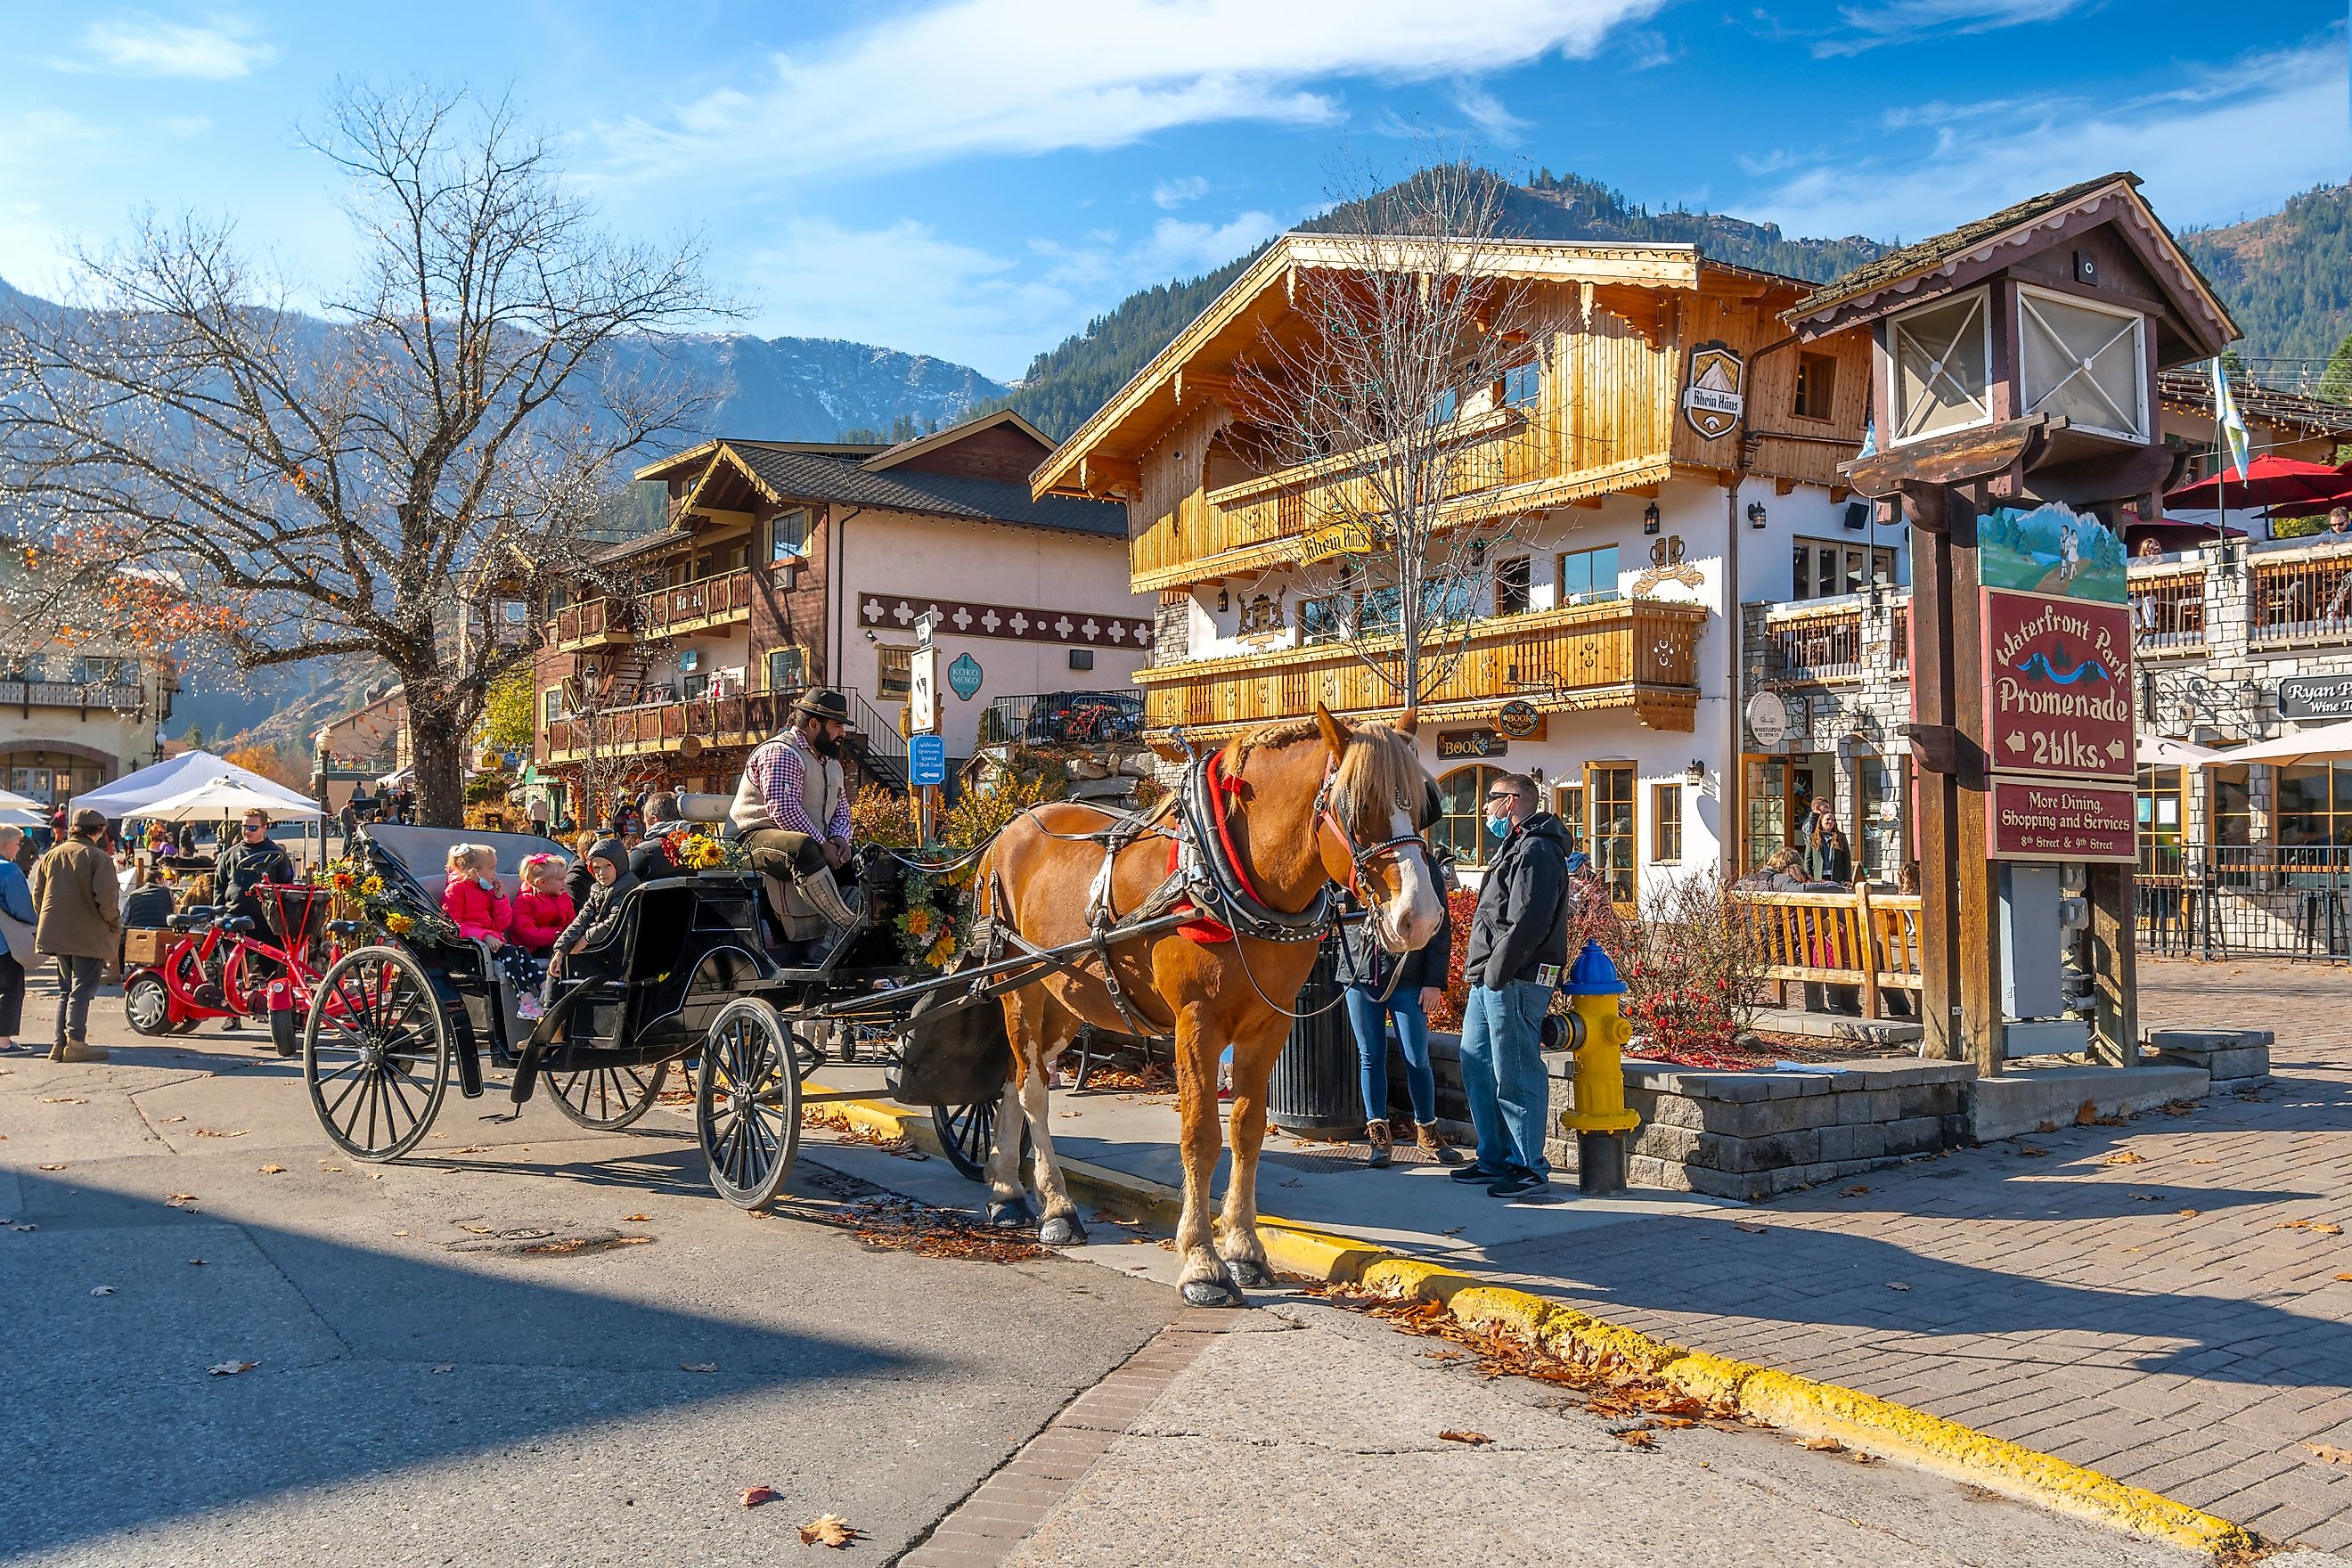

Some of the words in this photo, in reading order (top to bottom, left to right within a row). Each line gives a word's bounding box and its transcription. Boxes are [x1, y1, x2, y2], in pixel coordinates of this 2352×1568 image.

[1694, 390, 1717, 408] Rhein
[1305, 532, 1341, 559] Rhein
[676, 589, 702, 611] Hoel
[1996, 604, 2090, 667] Waterfront
[2095, 626, 2129, 686] Park
[952, 668, 978, 677] KOKO
[952, 676, 979, 684] MOKO
[1995, 676, 2128, 723] Promenade
[2288, 684, 2336, 704] Ryan
[2338, 682, 2352, 697] P
[2309, 700, 2340, 713] Wine
[1507, 714, 1535, 723] BOOK
[1444, 740, 1486, 755] BOOK
[2029, 791, 2058, 812] More
[2001, 809, 2056, 831] Shopping
[2060, 813, 2081, 829] and
[2083, 813, 2130, 831] Services
[2021, 835, 2033, 847] 8th
[2036, 836, 2060, 848] Street
[2063, 836, 2071, 847] &
[2075, 837, 2087, 849] 9th
[2089, 838, 2113, 850] Street
